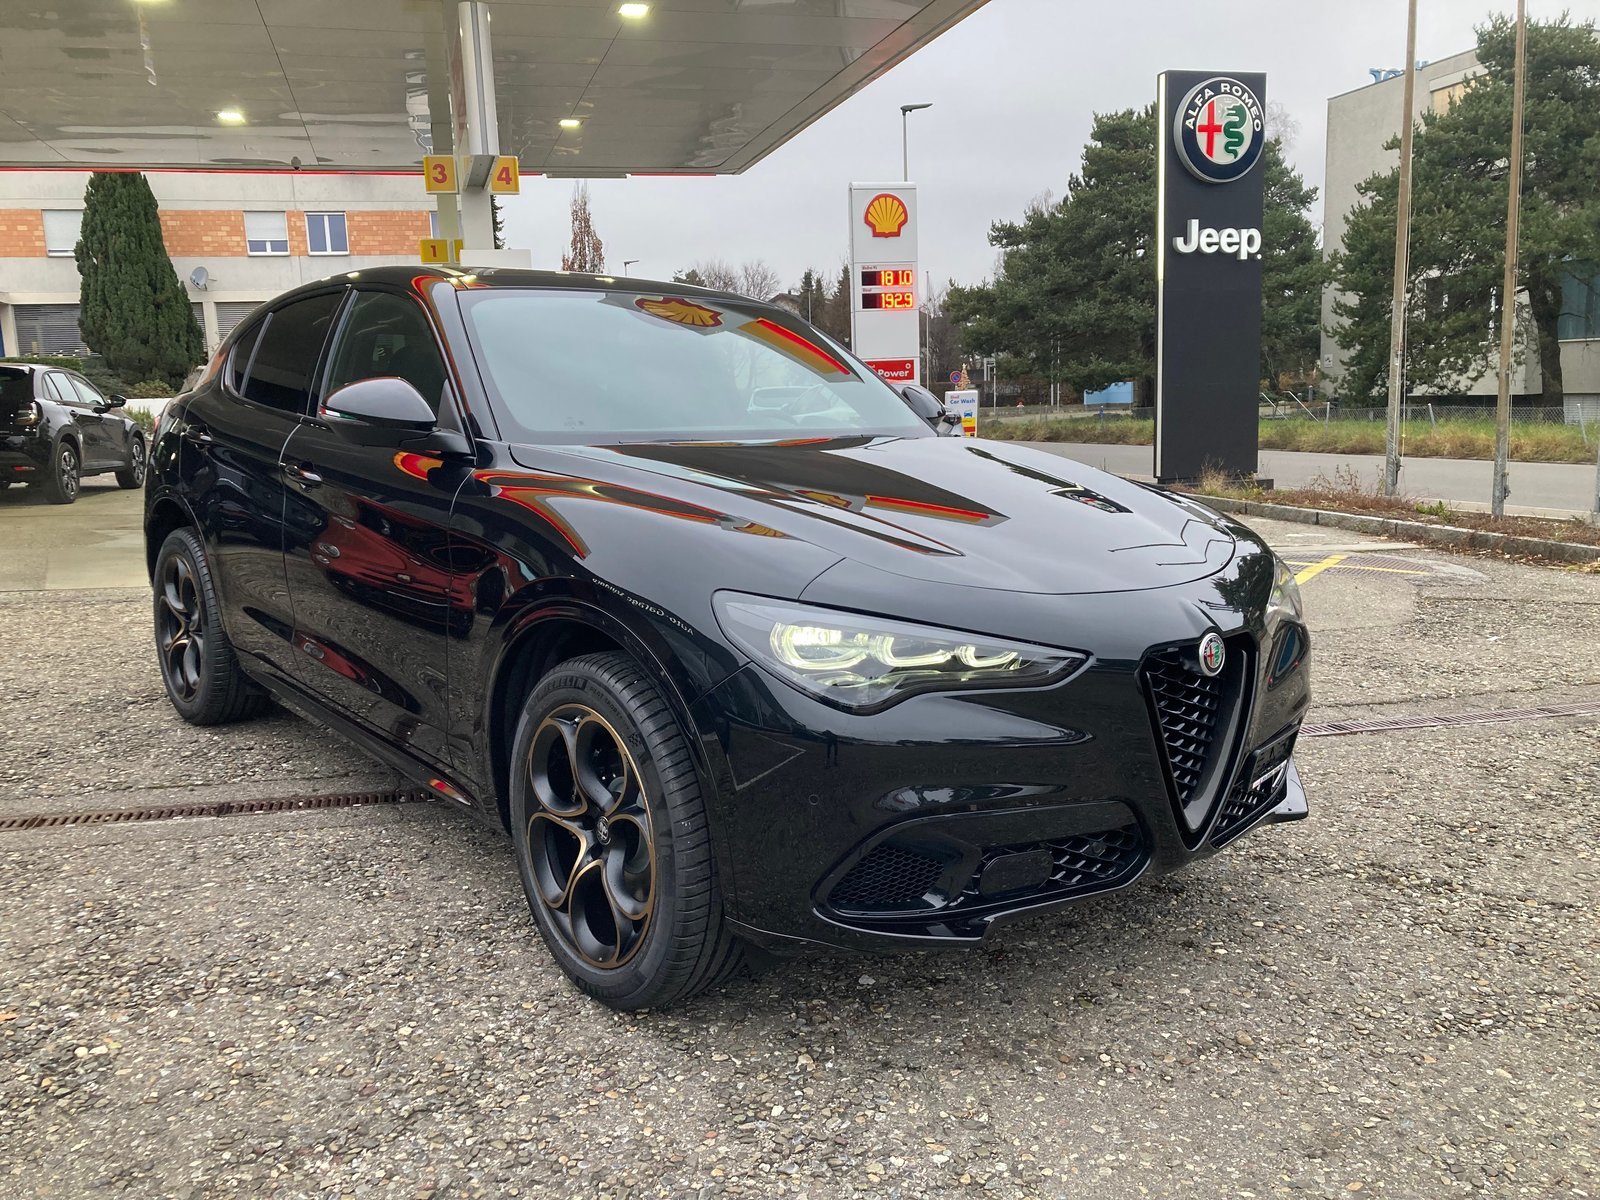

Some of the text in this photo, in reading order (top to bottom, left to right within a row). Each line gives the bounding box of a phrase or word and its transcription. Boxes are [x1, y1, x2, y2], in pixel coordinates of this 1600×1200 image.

[1185, 83, 1261, 132] ALFA ROMEO
[432, 164, 448, 184] 3
[496, 166, 512, 185] 4
[430, 244, 438, 258] 1
[881, 293, 913, 308] 192.9
